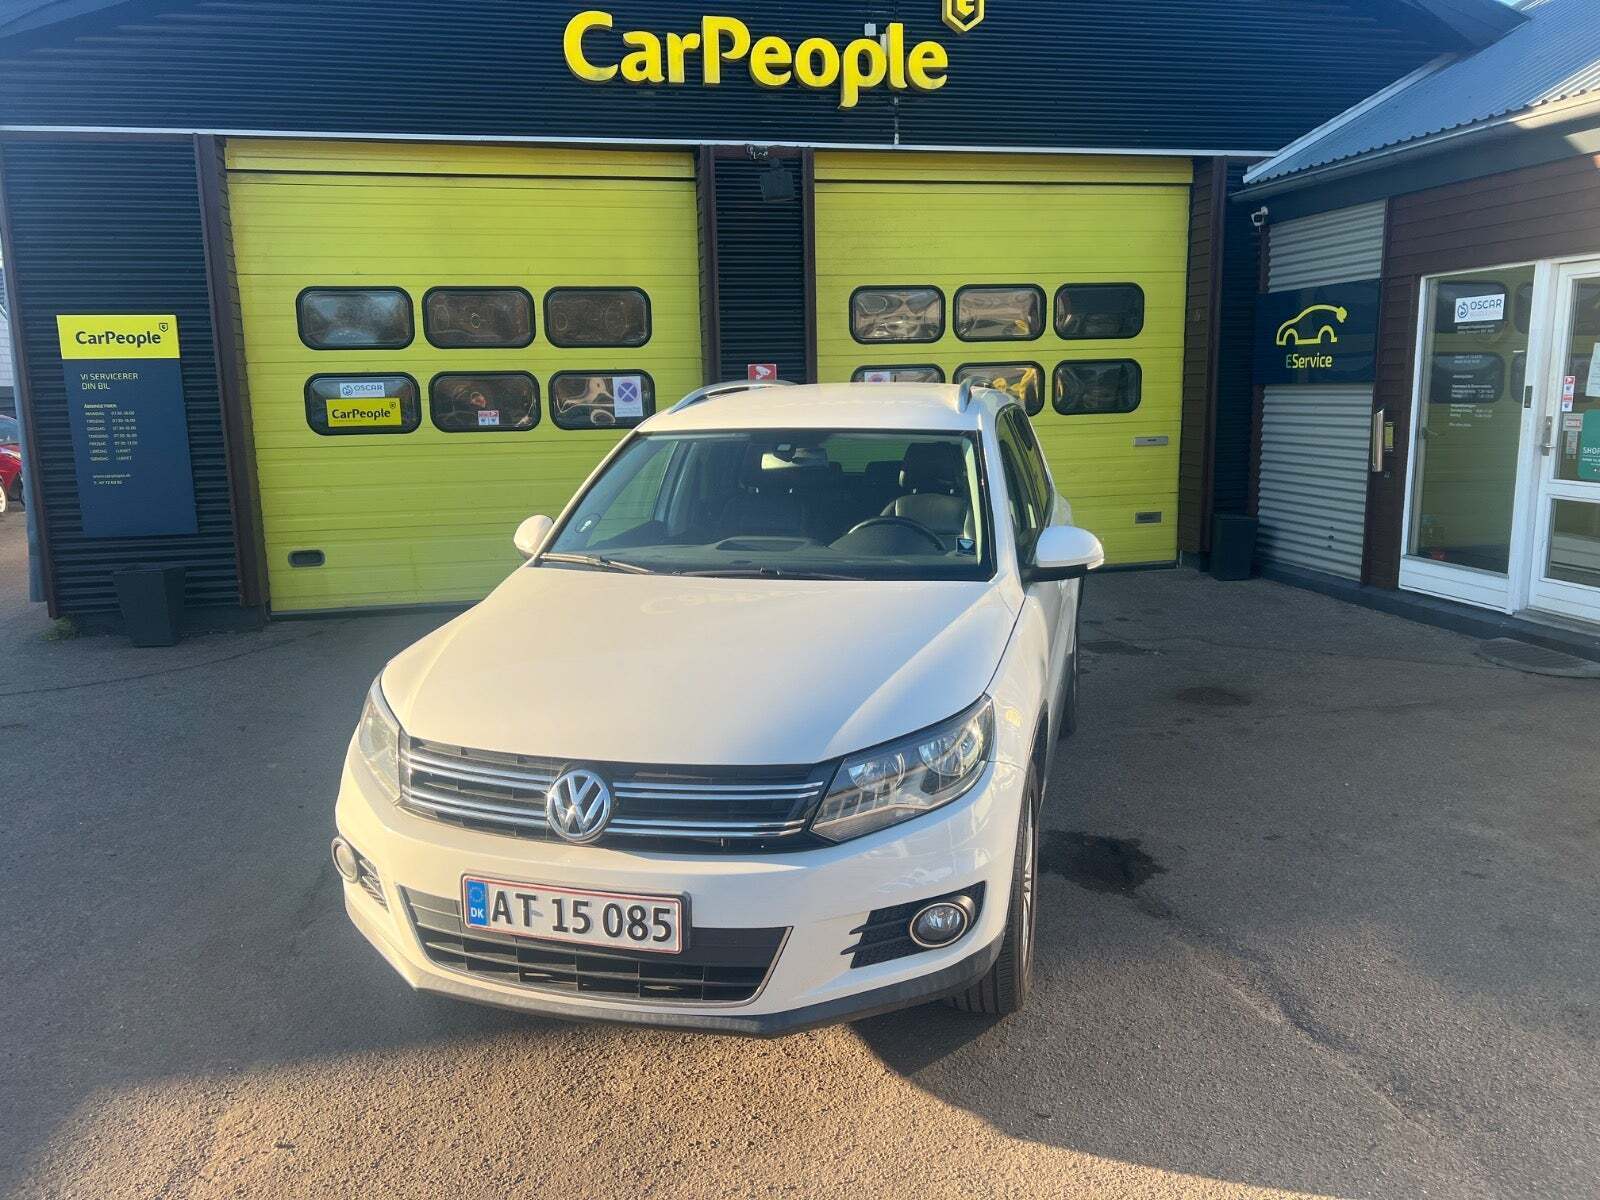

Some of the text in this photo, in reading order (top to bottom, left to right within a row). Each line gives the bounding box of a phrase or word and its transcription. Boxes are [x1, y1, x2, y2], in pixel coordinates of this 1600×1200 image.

[563, 10, 950, 110] CarPeople
[1470, 299, 1502, 310] OSCAR
[75, 331, 161, 348] CarPeople
[90, 372, 139, 380] SERVICERER
[81, 382, 111, 390] DIN BIL
[331, 408, 391, 421] CarPeople
[470, 906, 485, 920] DK
[491, 890, 672, 944] AT 15 085
